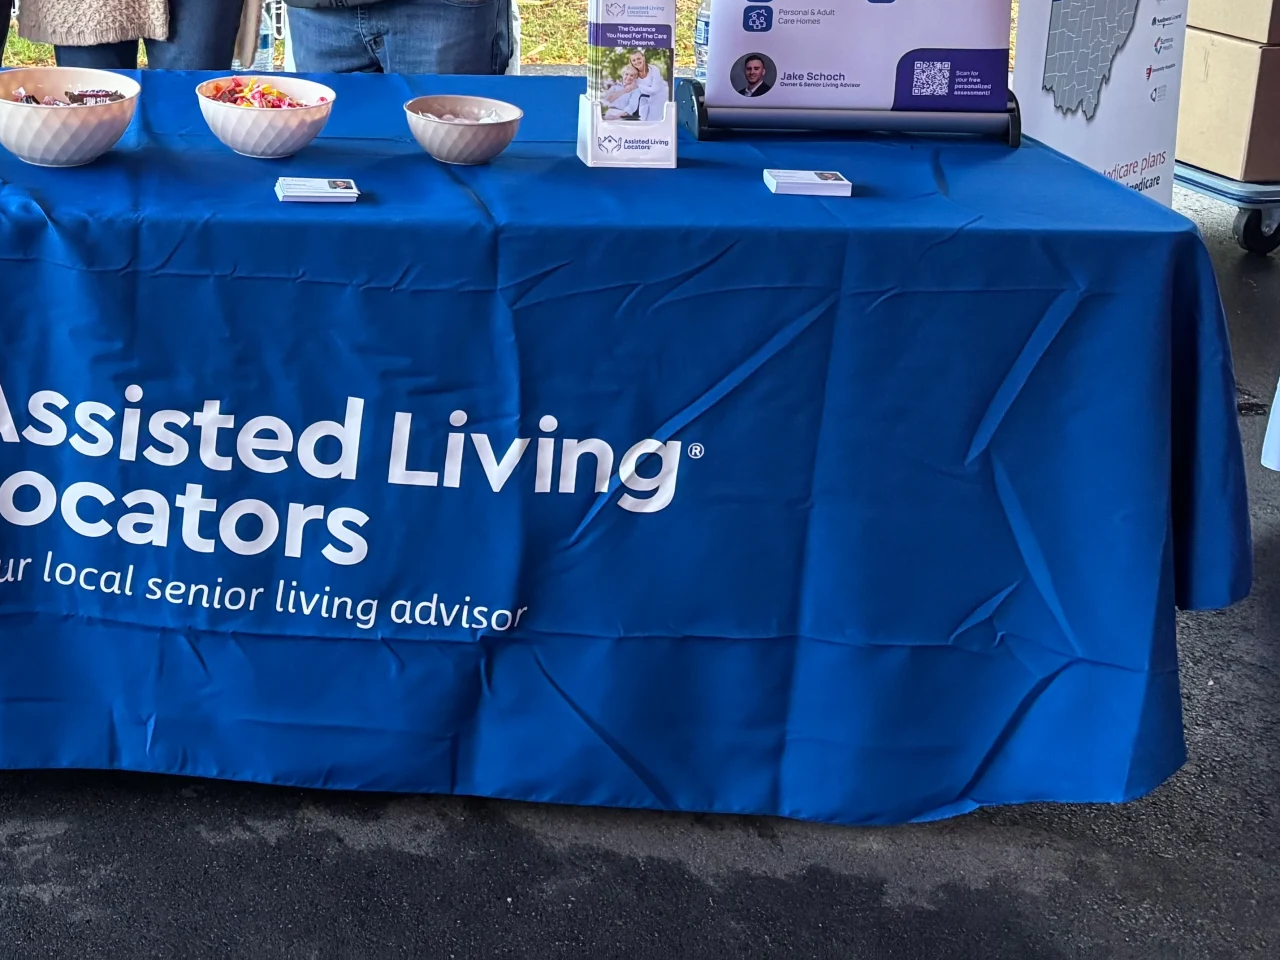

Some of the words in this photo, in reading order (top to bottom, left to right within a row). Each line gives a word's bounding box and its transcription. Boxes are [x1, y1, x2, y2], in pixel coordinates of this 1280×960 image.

[781, 72, 804, 80] Jake
[807, 72, 845, 81] Schoch
[1141, 151, 1166, 176] plans
[42, 558, 133, 598] local
[145, 574, 265, 614] senior
[275, 578, 377, 630] living
[390, 592, 527, 633] advisor
